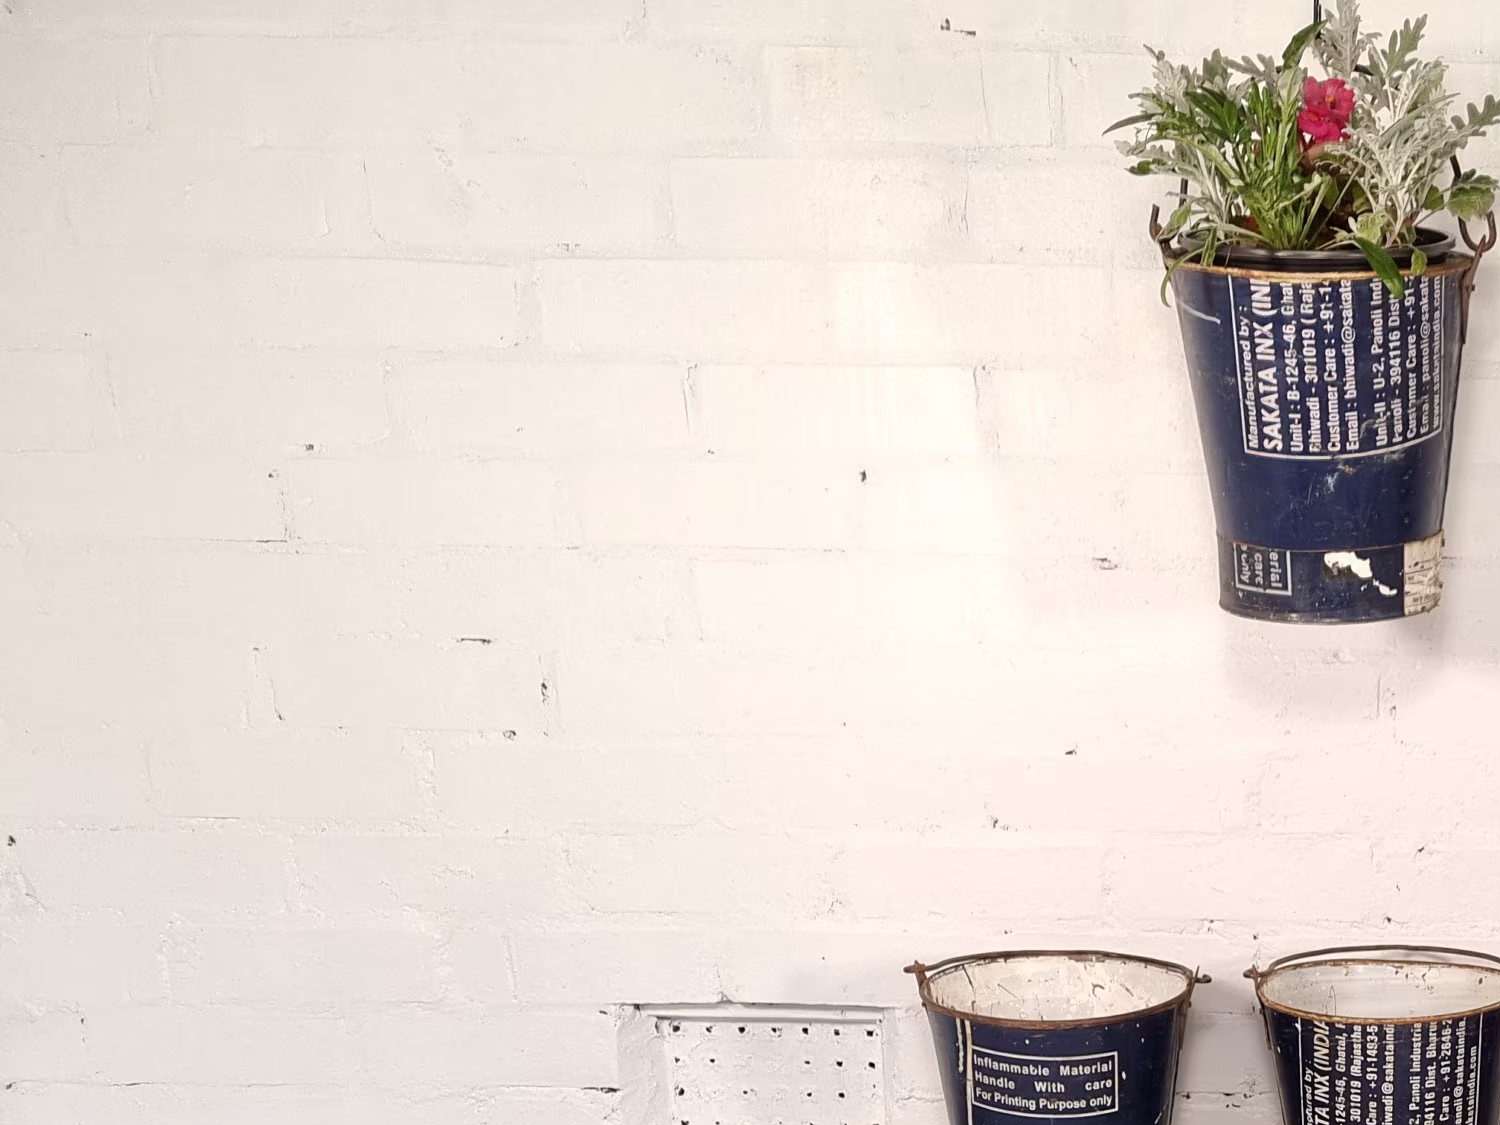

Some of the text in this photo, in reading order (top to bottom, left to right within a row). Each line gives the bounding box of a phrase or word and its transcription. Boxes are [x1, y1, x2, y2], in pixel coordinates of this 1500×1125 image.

[1252, 321, 1276, 361] INX
[1370, 309, 1383, 354] Panoli
[1301, 328, 1318, 384] 301019
[1388, 330, 1402, 386] 394116
[1406, 335, 1416, 369] Care
[1239, 340, 1259, 449] Manufactured
[1257, 366, 1283, 452] SAKATA
[1324, 348, 1341, 452] Customer Care
[1345, 411, 1360, 451] Email
[973, 1054, 1112, 1077] Inflammable Material
[974, 1070, 1113, 1093] Handle With care
[975, 1088, 1113, 1112] For Printing Purpose only
[1313, 1072, 1330, 1104] INX
[1350, 1081, 1361, 1122] 301019
[1408, 1076, 1421, 1111] Panoli
[1439, 1095, 1450, 1121] Care
[1366, 1101, 1377, 1125] Care
